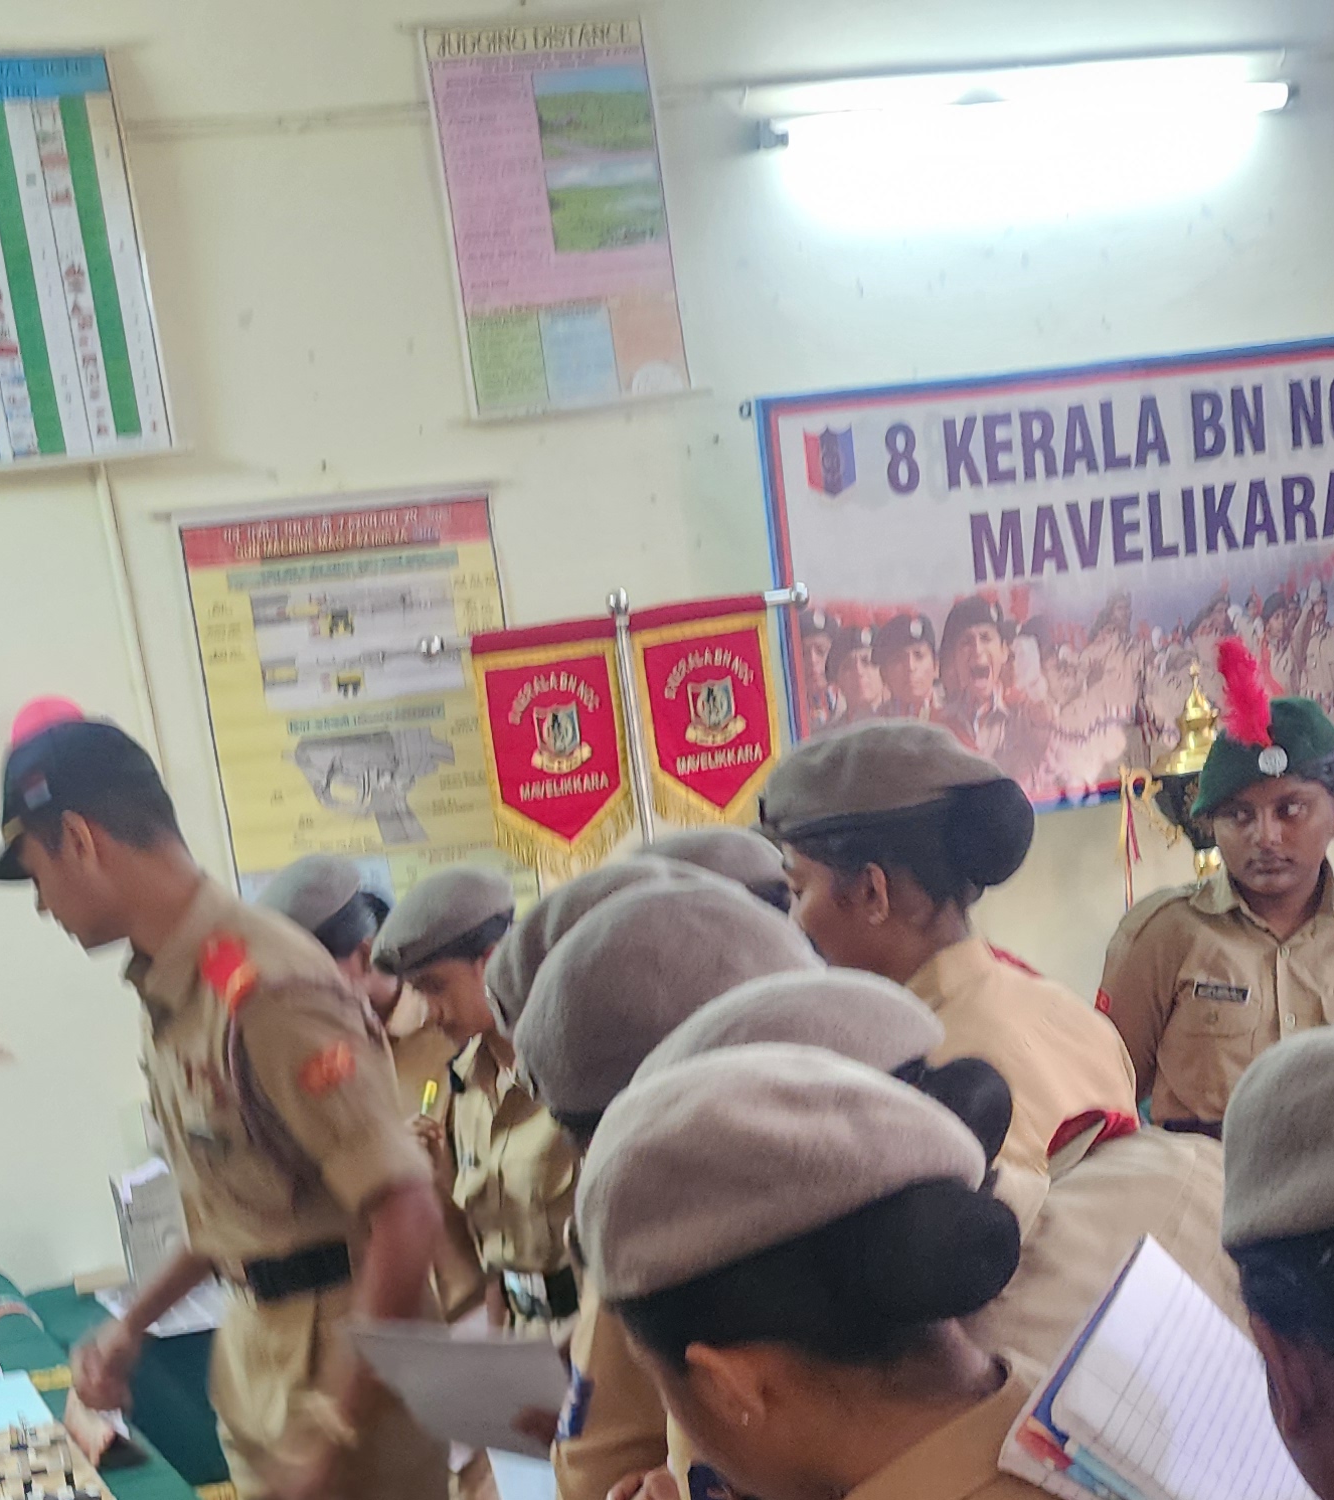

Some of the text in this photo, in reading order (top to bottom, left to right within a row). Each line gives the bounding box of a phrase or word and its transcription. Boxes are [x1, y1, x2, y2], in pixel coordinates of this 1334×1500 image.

[437, 22, 631, 58] JUDGING DISTANCE
[884, 423, 920, 494] 8
[943, 394, 1170, 492] KERALA
[1191, 386, 1267, 463] BN
